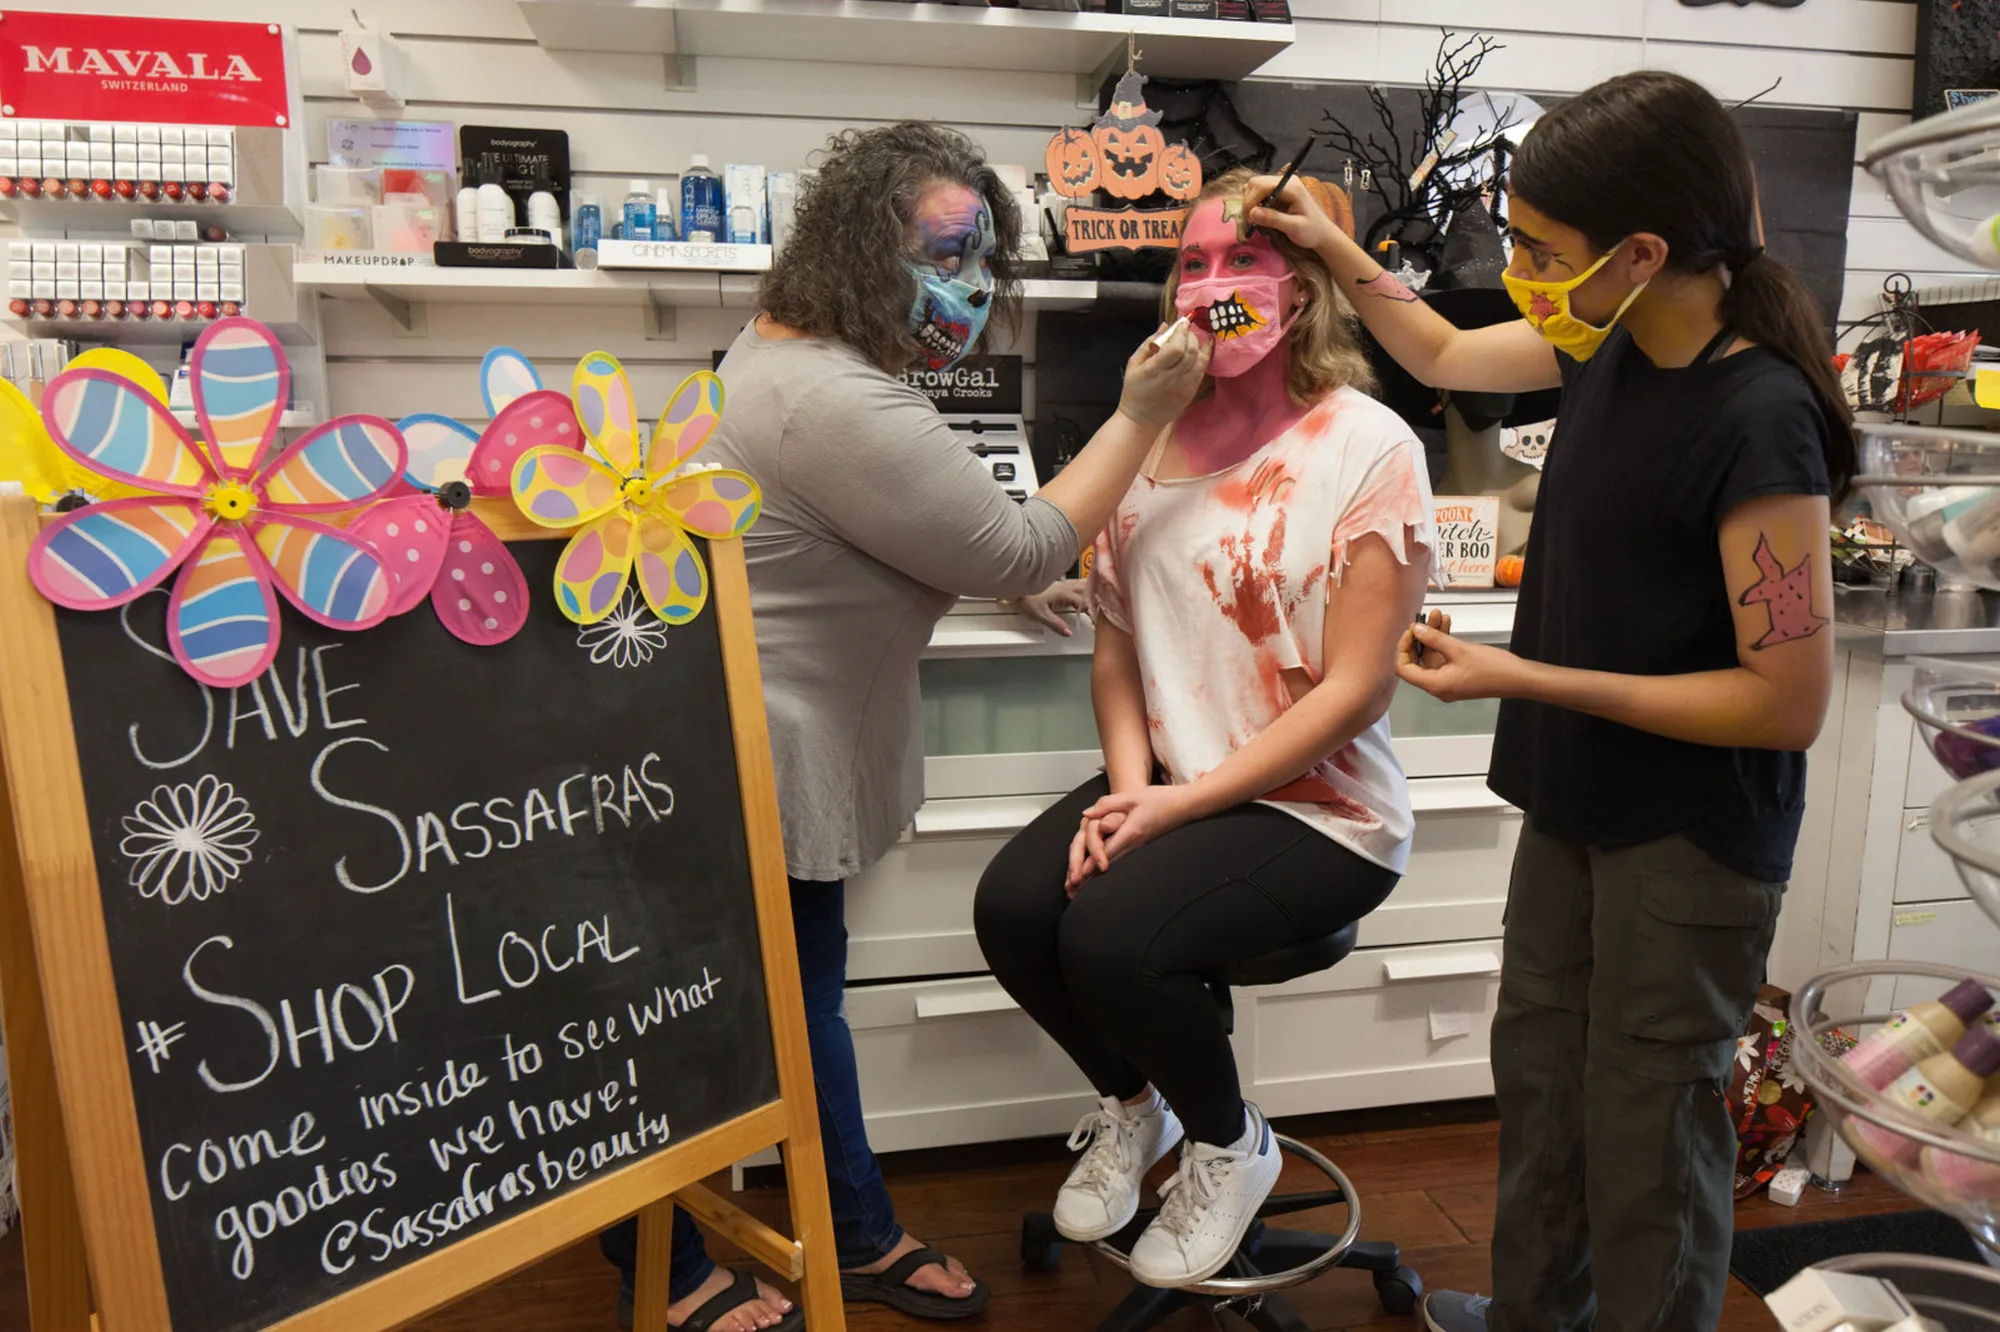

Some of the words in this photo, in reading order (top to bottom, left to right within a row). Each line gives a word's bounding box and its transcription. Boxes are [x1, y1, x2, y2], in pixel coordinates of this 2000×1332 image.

[21, 45, 262, 81] MAVALA
[101, 79, 188, 93] SWITZERLAND
[490, 138, 537, 148] bodyography
[1072, 219, 1116, 240] TRICK
[1120, 219, 1140, 240] OR
[1143, 220, 1179, 239] TREA
[468, 246, 523, 256] bodyography
[953, 387, 993, 397] Crooks
[1438, 519, 1494, 541] itch
[1460, 541, 1490, 558] BOO
[355, 1060, 490, 1129] inside
[501, 1033, 543, 1082] to
[558, 1021, 621, 1059] see
[215, 1152, 397, 1280] goodies
[429, 1114, 505, 1172] we
[508, 1058, 639, 1140] have!
